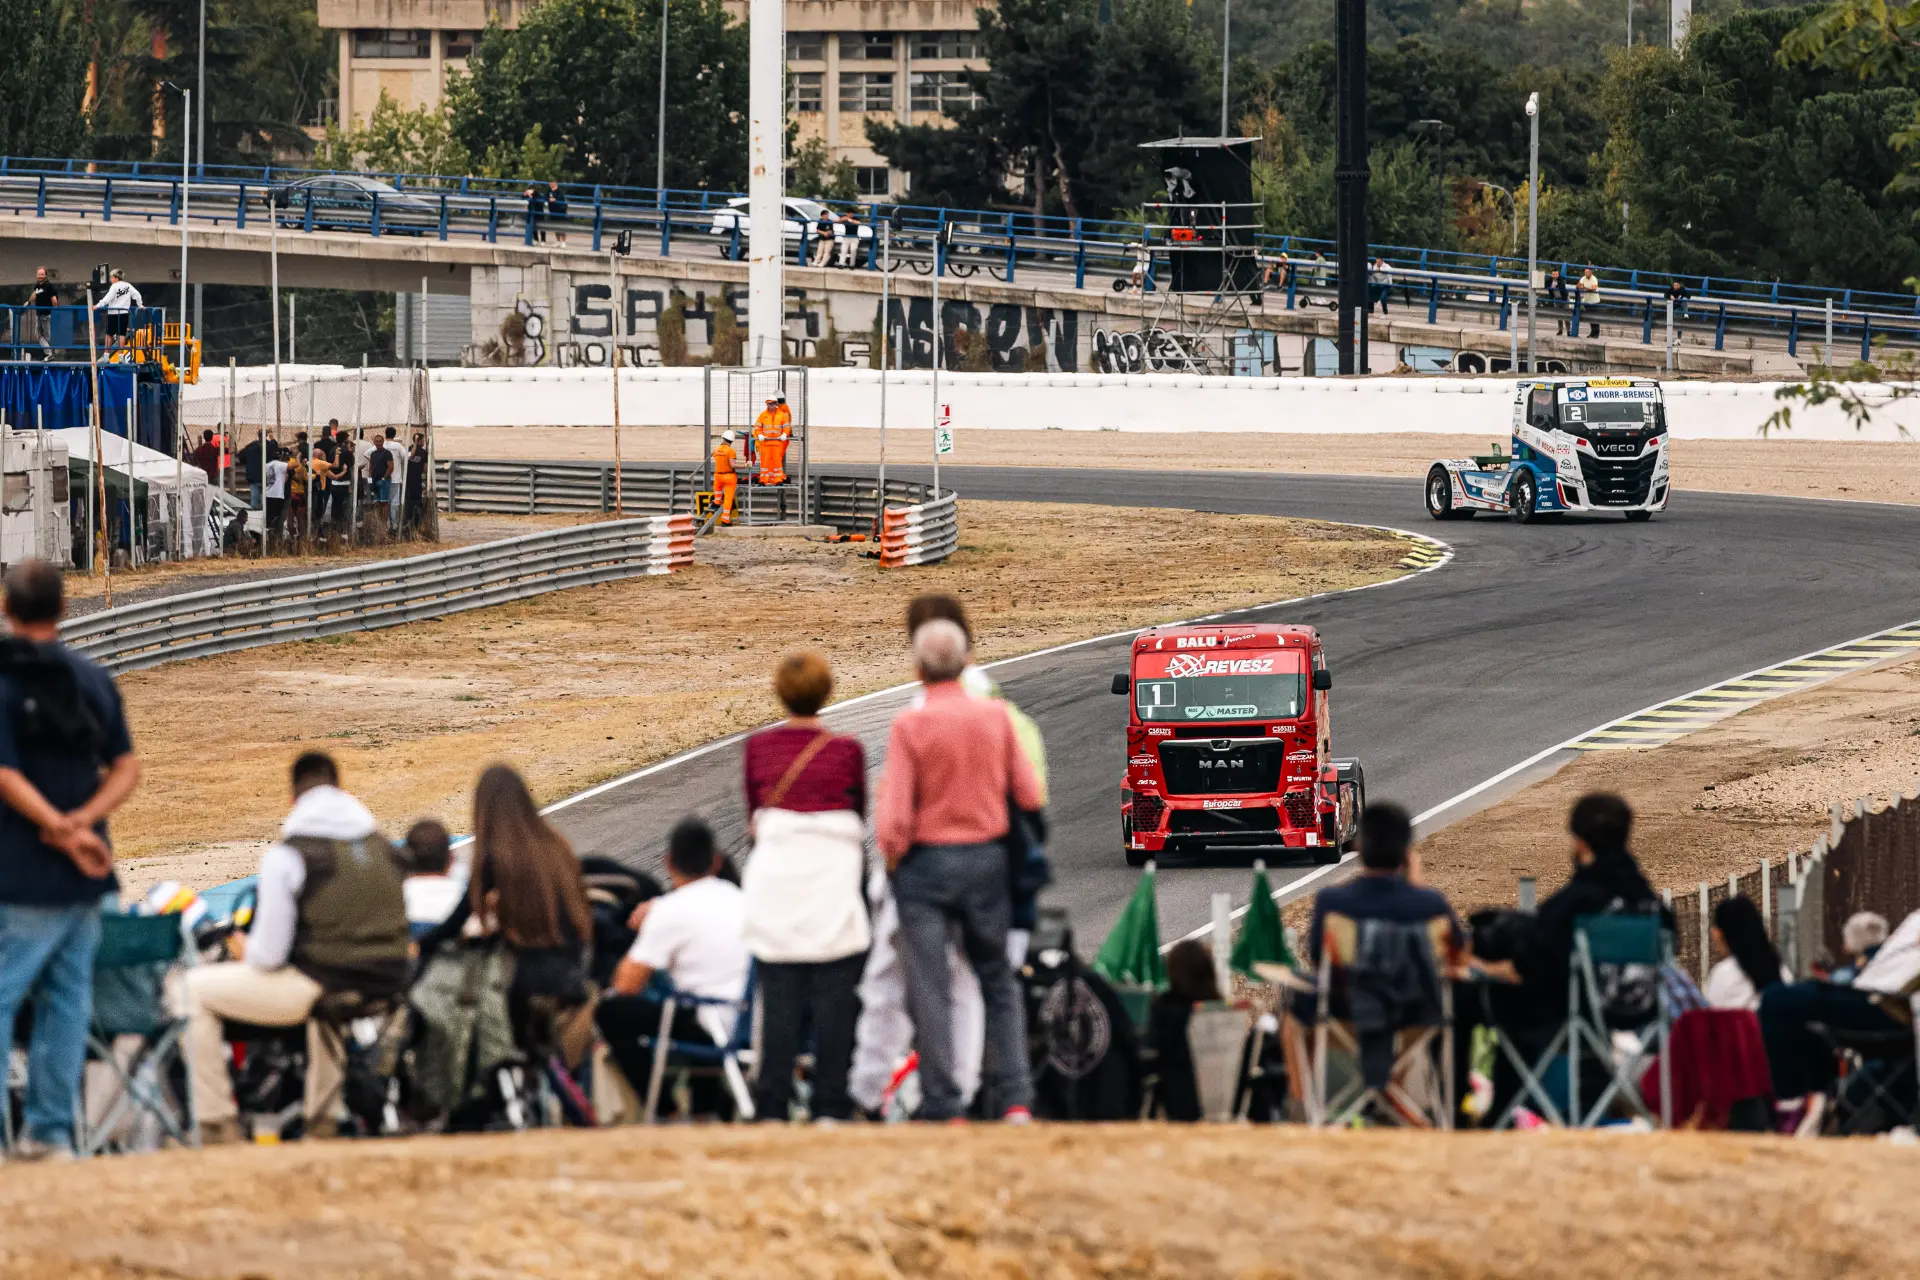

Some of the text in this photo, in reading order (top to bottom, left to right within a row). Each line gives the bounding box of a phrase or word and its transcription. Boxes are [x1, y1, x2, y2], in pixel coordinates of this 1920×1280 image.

[1594, 391, 1654, 399] KNORR-BREMSE
[1571, 407, 1582, 420] 2
[1597, 444, 1635, 452] IVECO
[1177, 634, 1257, 648] BALU Junior
[1152, 685, 1160, 705] 1
[1199, 760, 1243, 768] MAN
[1203, 800, 1242, 809] Europcar
